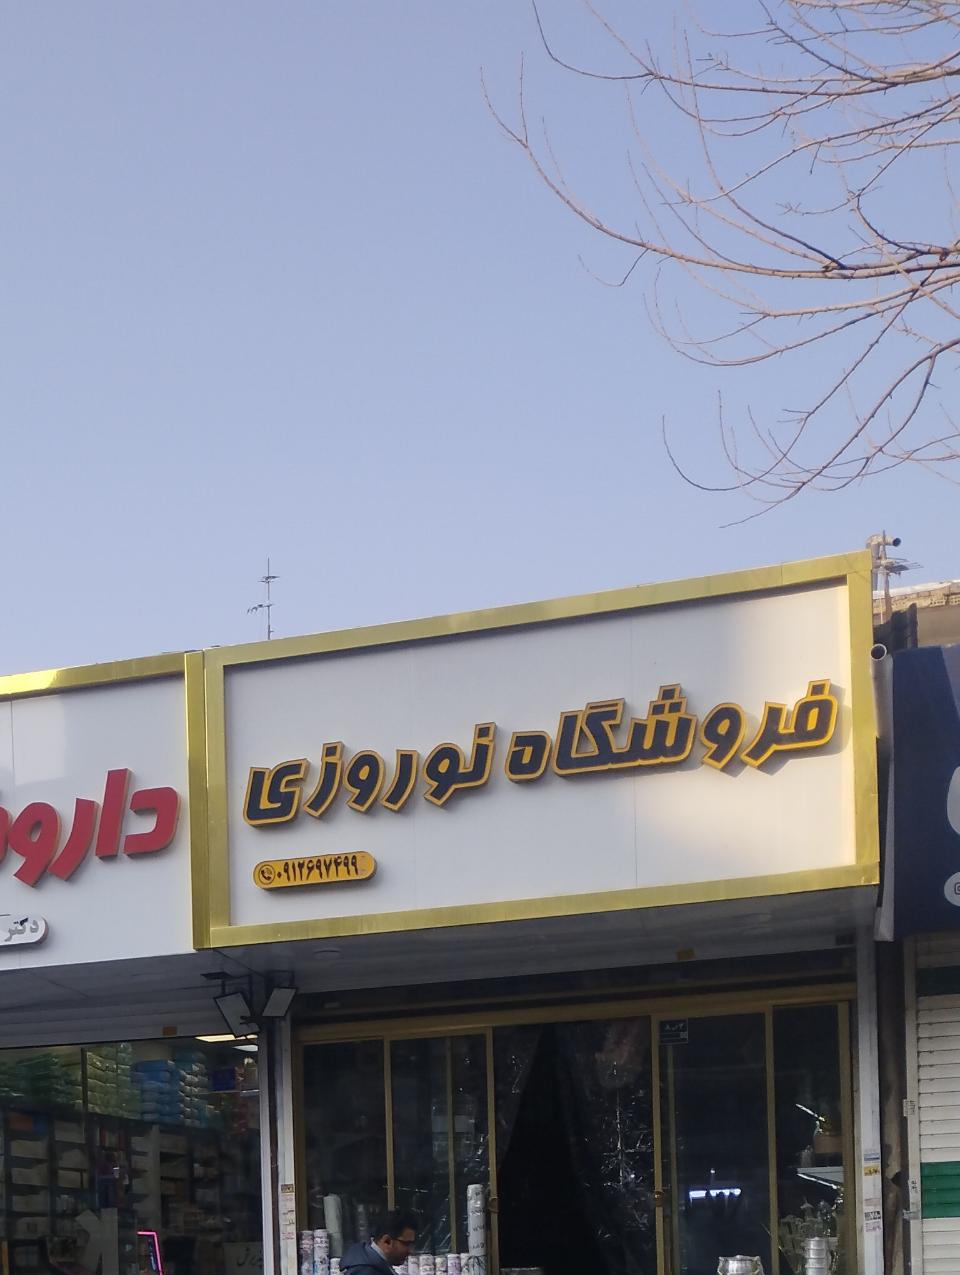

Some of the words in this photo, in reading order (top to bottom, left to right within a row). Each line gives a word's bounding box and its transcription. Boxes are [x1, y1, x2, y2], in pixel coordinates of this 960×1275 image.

[242, 722, 497, 828] نوروزی
[504, 678, 839, 784] فروشگاه
[4, 917, 39, 942] دکتر
